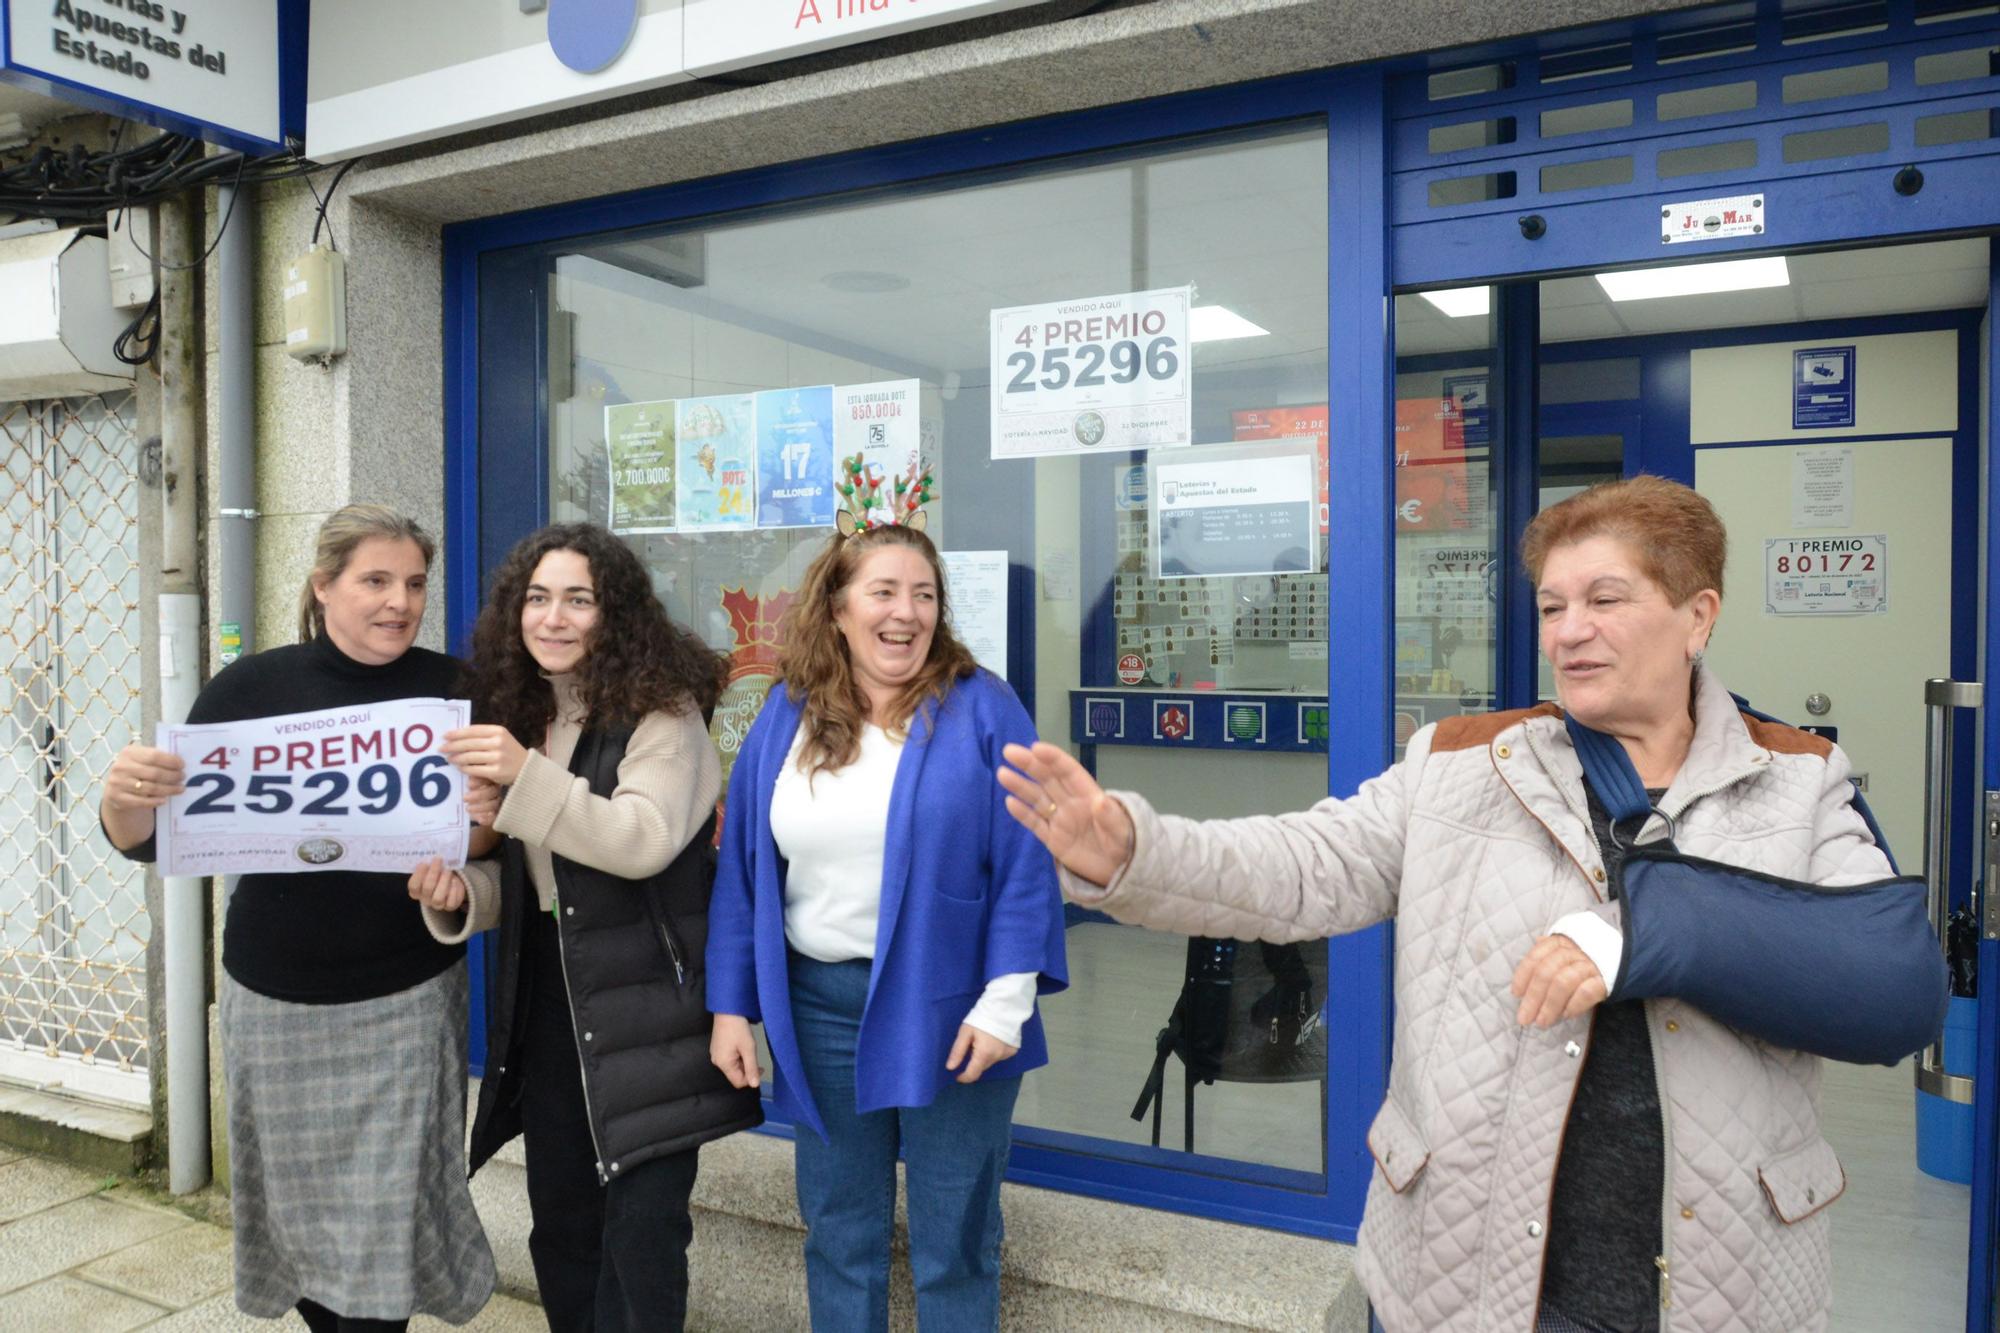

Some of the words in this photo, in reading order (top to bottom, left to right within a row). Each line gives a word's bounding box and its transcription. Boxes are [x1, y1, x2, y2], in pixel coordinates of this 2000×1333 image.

[171, 9, 187, 34] y
[52, 0, 181, 59] Apuestas
[187, 43, 226, 75] del
[53, 28, 150, 80] Estado
[1057, 304, 1097, 314] VENDIDO
[1099, 301, 1121, 310] AQUÍ
[1045, 310, 1166, 346] PREMIO
[1006, 336, 1178, 394] 25296
[848, 395, 862, 405] ESTA
[864, 393, 889, 403] JORNADA
[852, 402, 902, 420] 850.000€
[871, 427, 883, 441] 75
[1295, 421, 1307, 430] 22
[1311, 419, 1324, 428] DE
[781, 443, 811, 480] 17
[721, 471, 746, 486] BOTE
[772, 487, 813, 498] MILLONES
[1179, 488, 1214, 498] Apuestas
[1231, 486, 1258, 494] Estado
[1802, 540, 1863, 552] PREMIO
[1777, 553, 1875, 573] 80172
[274, 717, 336, 735] VENDIDO
[340, 711, 372, 726] AQUÍ
[253, 723, 434, 772] PREMIO
[184, 755, 451, 817] 25296
